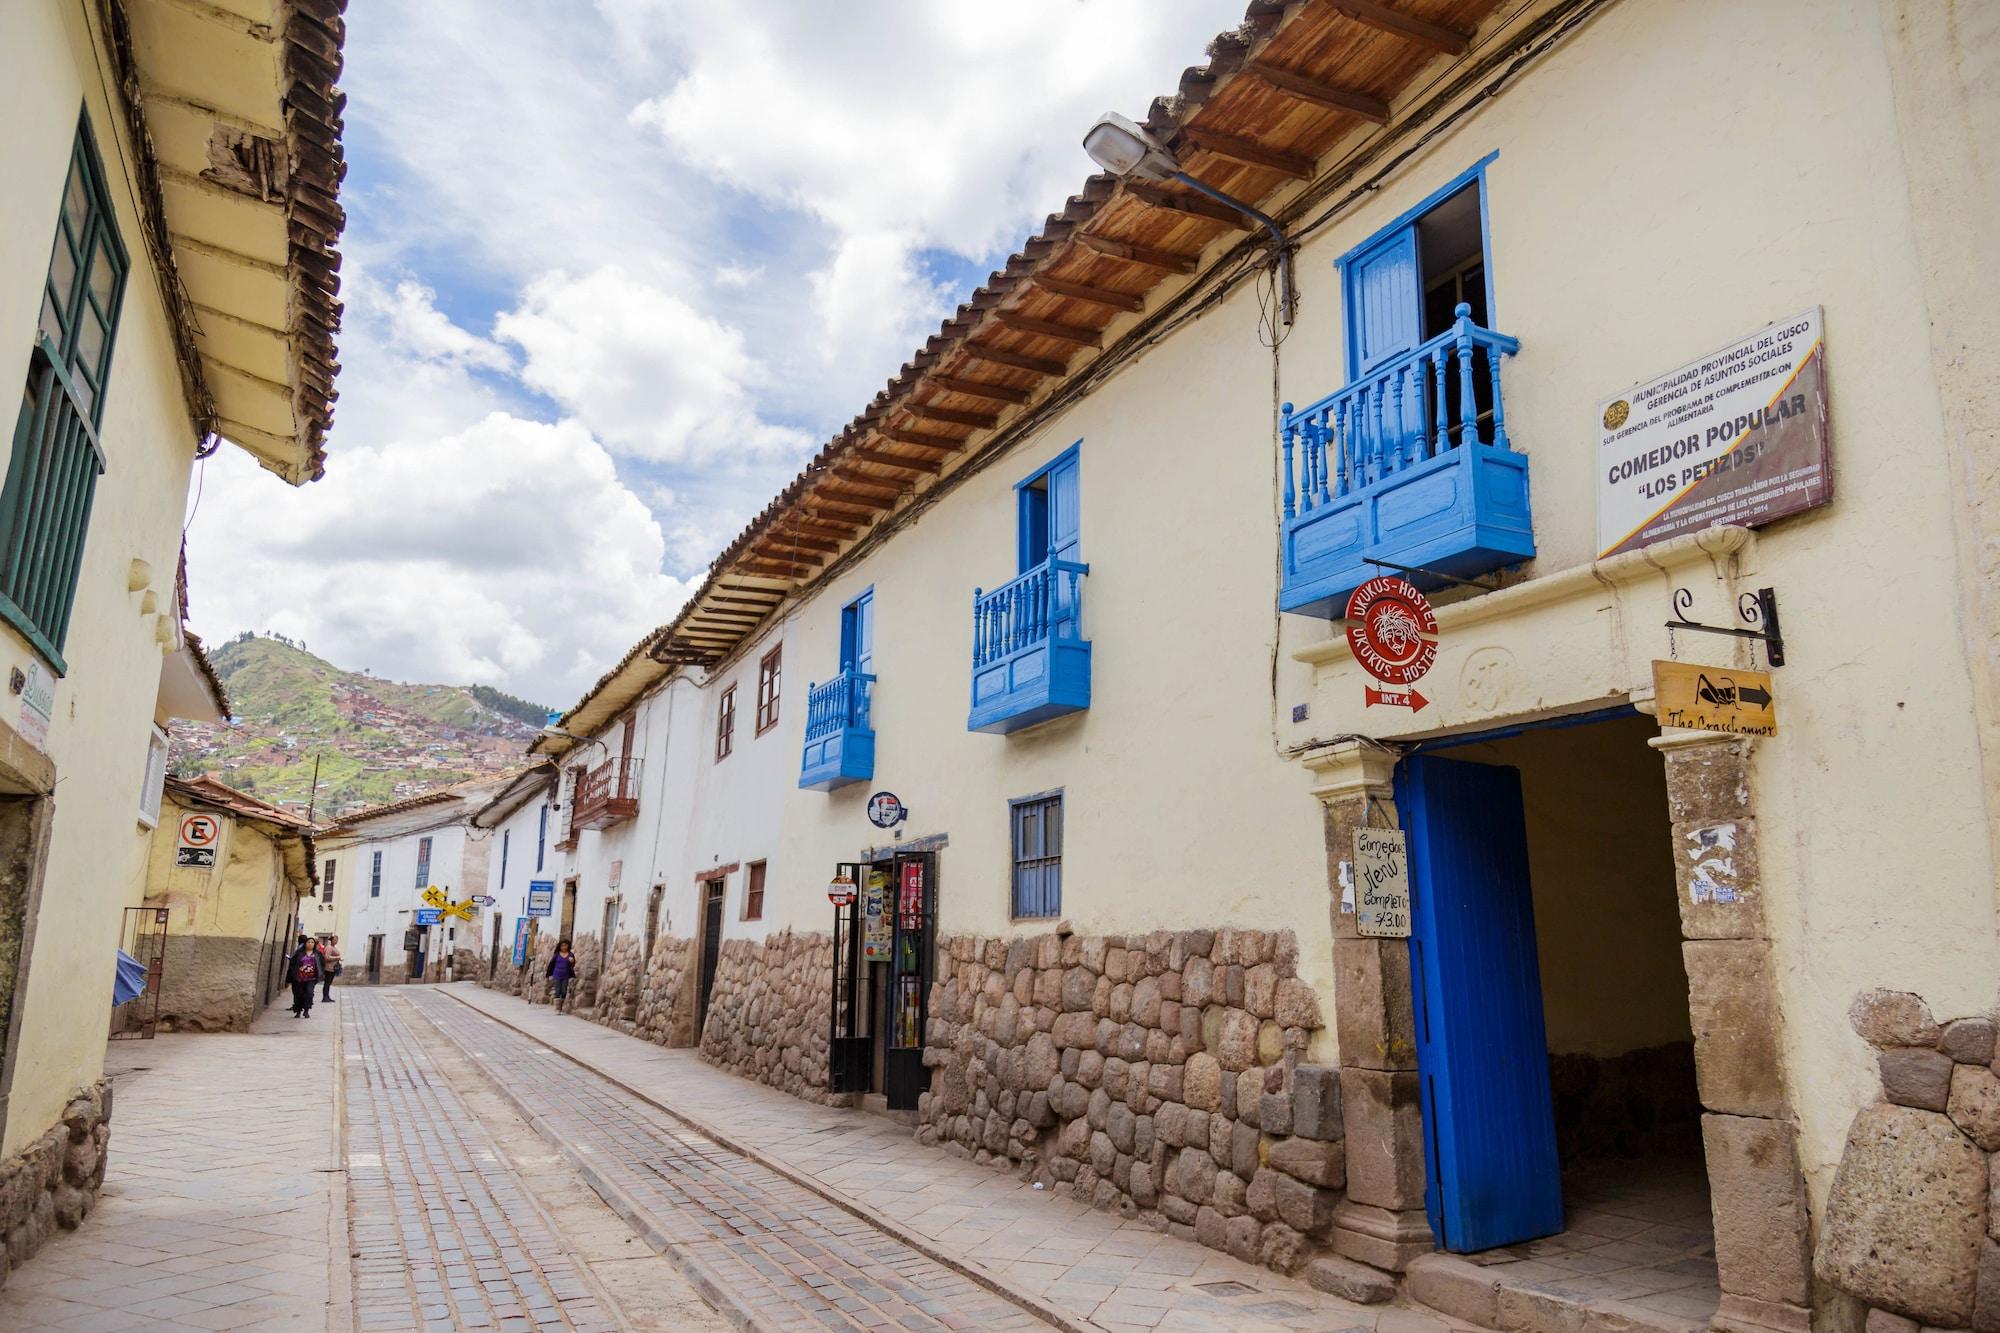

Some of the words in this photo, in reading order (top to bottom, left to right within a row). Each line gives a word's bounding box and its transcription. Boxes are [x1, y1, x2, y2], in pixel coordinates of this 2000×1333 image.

[1633, 368, 1699, 404] MUNICIPALIDAD
[1701, 344, 1755, 375] PROVINCIAL
[1757, 335, 1774, 351] DEL
[1777, 321, 1809, 342] CUSCO
[1647, 386, 1688, 410] GERENCIA
[1690, 381, 1702, 393] DE
[1704, 361, 1746, 387] ASUNTOS
[1748, 341, 1793, 368] SOCIALES
[1603, 435, 1615, 446] SUB
[1616, 421, 1648, 440] GERENCIA
[1649, 416, 1661, 426] DEL
[1663, 398, 1702, 421] PROGRAMA
[1704, 393, 1714, 403] DE
[1609, 434, 1700, 484] COMEDOR
[1706, 394, 1806, 448] POPULAR
[1667, 404, 1714, 429] ALIMENTARIA
[1663, 511, 1670, 520] LA
[1707, 497, 1717, 507] DEL
[1717, 491, 1735, 503] CUSCO
[1769, 475, 1781, 486] POR
[1781, 473, 1788, 482] LA
[1681, 518, 1688, 527] LA
[1688, 506, 1727, 524] OPERATIVIDAD
[1728, 502, 1736, 511] DE
[1736, 498, 1748, 509] LOS
[1748, 487, 1785, 505] COMEDORES
[1785, 475, 1821, 494] POPULARES
[1711, 513, 1736, 528] GESTION
[1753, 503, 1769, 515] 2014
[1354, 578, 1390, 616] UKUKUS
[1399, 581, 1436, 631] HOSTEL
[1353, 628, 1392, 678] UKUKUS
[1402, 645, 1438, 682] HOSTEL
[1381, 693, 1400, 705] INT.
[1402, 696, 1410, 705] 4
[191, 821, 208, 839] E
